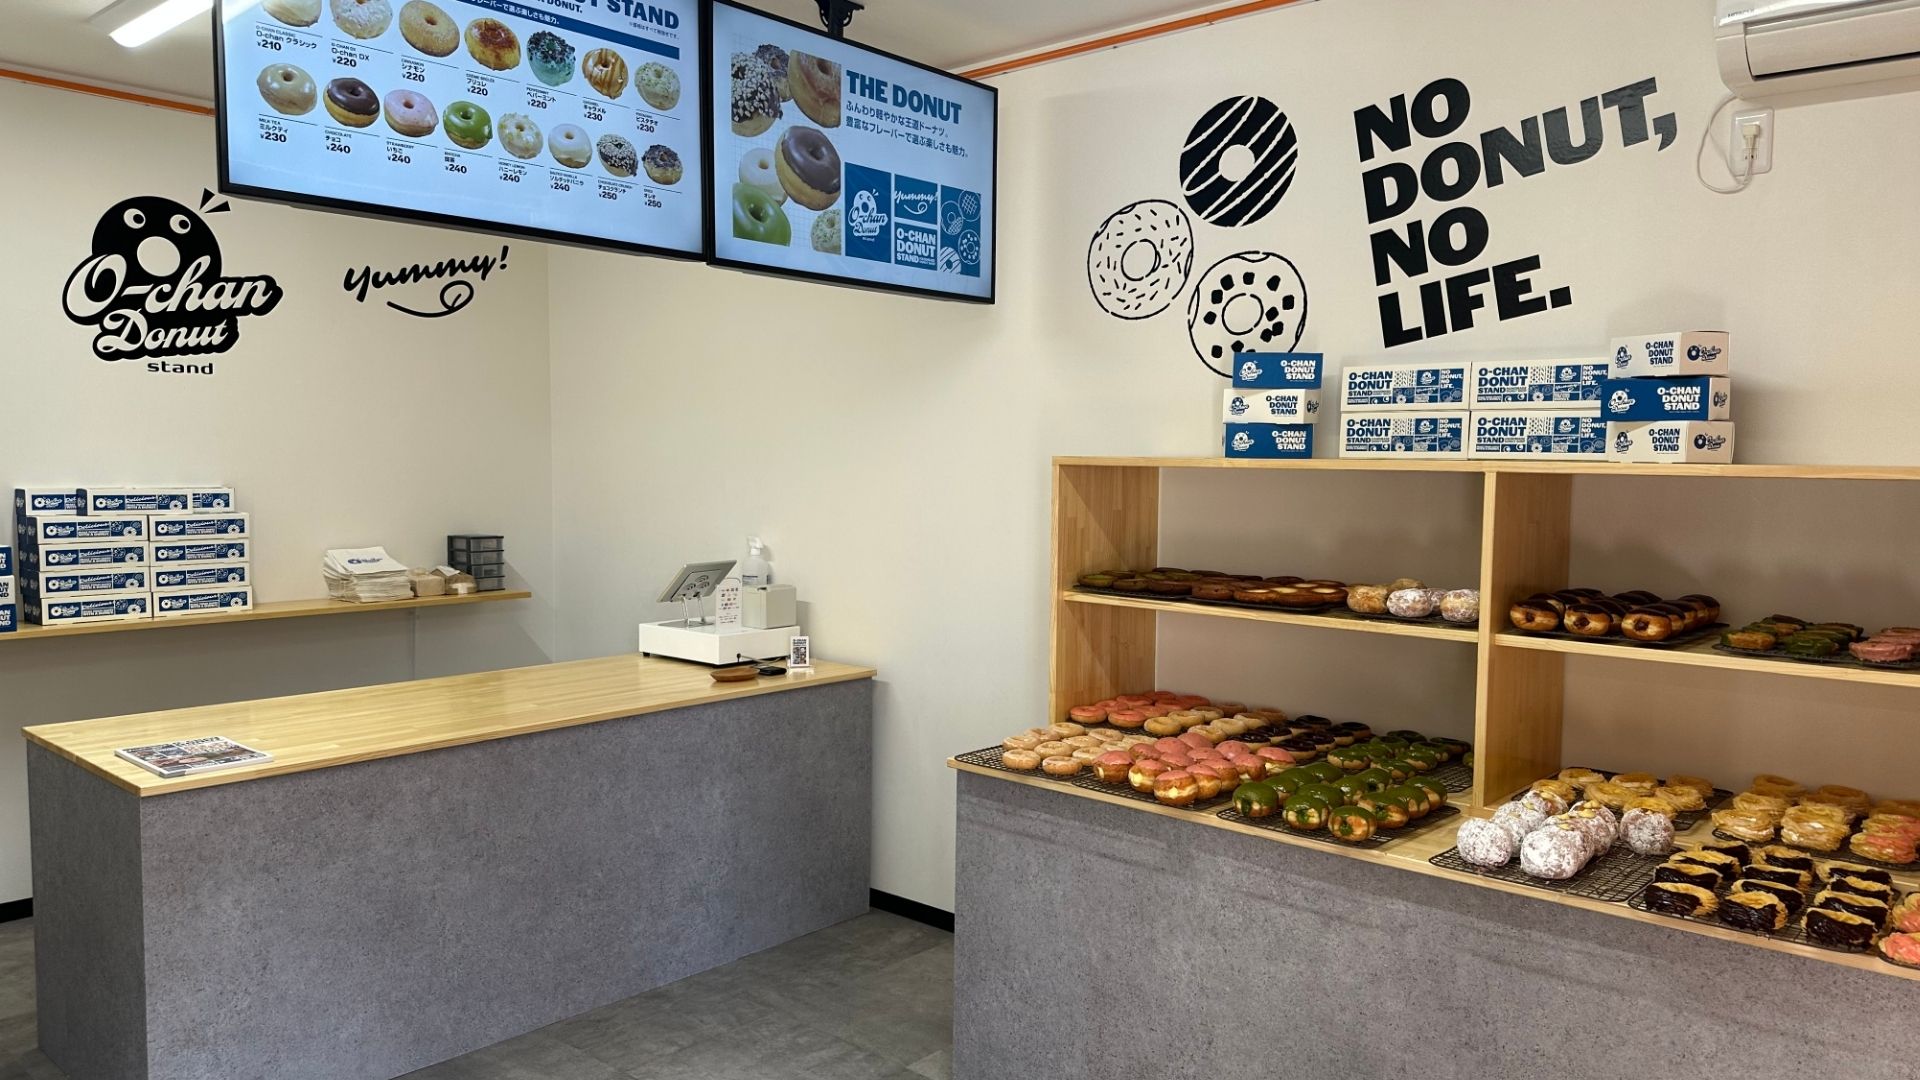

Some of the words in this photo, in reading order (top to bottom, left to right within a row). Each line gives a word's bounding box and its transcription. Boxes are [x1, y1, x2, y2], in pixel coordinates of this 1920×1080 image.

[607, 0, 680, 30] STAND
[256, 30, 284, 42] O-chan
[286, 38, 317, 49] クラシック
[257, 40, 282, 51] ¥210
[331, 47, 358, 59] O-chan
[358, 53, 370, 61] DX
[332, 56, 357, 67] ¥220
[402, 64, 425, 73] シナモン
[402, 71, 425, 82] ¥220
[467, 85, 488, 96] ¥220
[846, 69, 888, 103] THE
[892, 84, 962, 124] DONUT
[528, 100, 547, 109] ¥220
[584, 112, 603, 121] ¥230
[846, 100, 949, 138] ふんわり軽やかな王道ドーナツ。
[1354, 78, 1471, 163] NO
[637, 124, 655, 133] ¥230
[260, 131, 287, 143] ¥230
[326, 143, 351, 154] ¥240
[1362, 77, 1678, 225] DONUT,
[387, 153, 411, 164] ¥240
[445, 163, 467, 174] ¥240
[499, 173, 520, 182] ¥240
[550, 182, 570, 192] ¥240
[599, 192, 617, 201] ¥250
[645, 200, 662, 209] ¥250
[896, 227, 936, 245] O-CHAN
[896, 239, 936, 258] DONUT
[1370, 206, 1489, 287] NO
[896, 252, 919, 263] STAND
[66, 253, 274, 318] O-chan
[1378, 254, 1572, 348] LIFE.
[96, 308, 228, 353] Donut
[1645, 340, 1674, 349] O-CHAN
[1648, 349, 1674, 357] DONUT
[1649, 356, 1673, 365] STAND
[147, 361, 214, 375] stand
[1479, 366, 1528, 376] O-CHAN
[1349, 370, 1393, 380] O-CHAN
[1348, 380, 1393, 390] DONUT
[1478, 376, 1528, 387] DONUT
[1657, 386, 1701, 395] O-CHAN
[1661, 394, 1700, 402] DONUT
[1664, 402, 1700, 410] STAND
[1346, 418, 1391, 427] O-CHAN
[1478, 417, 1527, 426] O-CHAN
[1346, 427, 1391, 437] DONUT
[1477, 426, 1527, 436] DONUT
[1648, 429, 1680, 437] O-CHAN
[1652, 436, 1680, 444] DONUT
[1653, 443, 1679, 451] STAND
